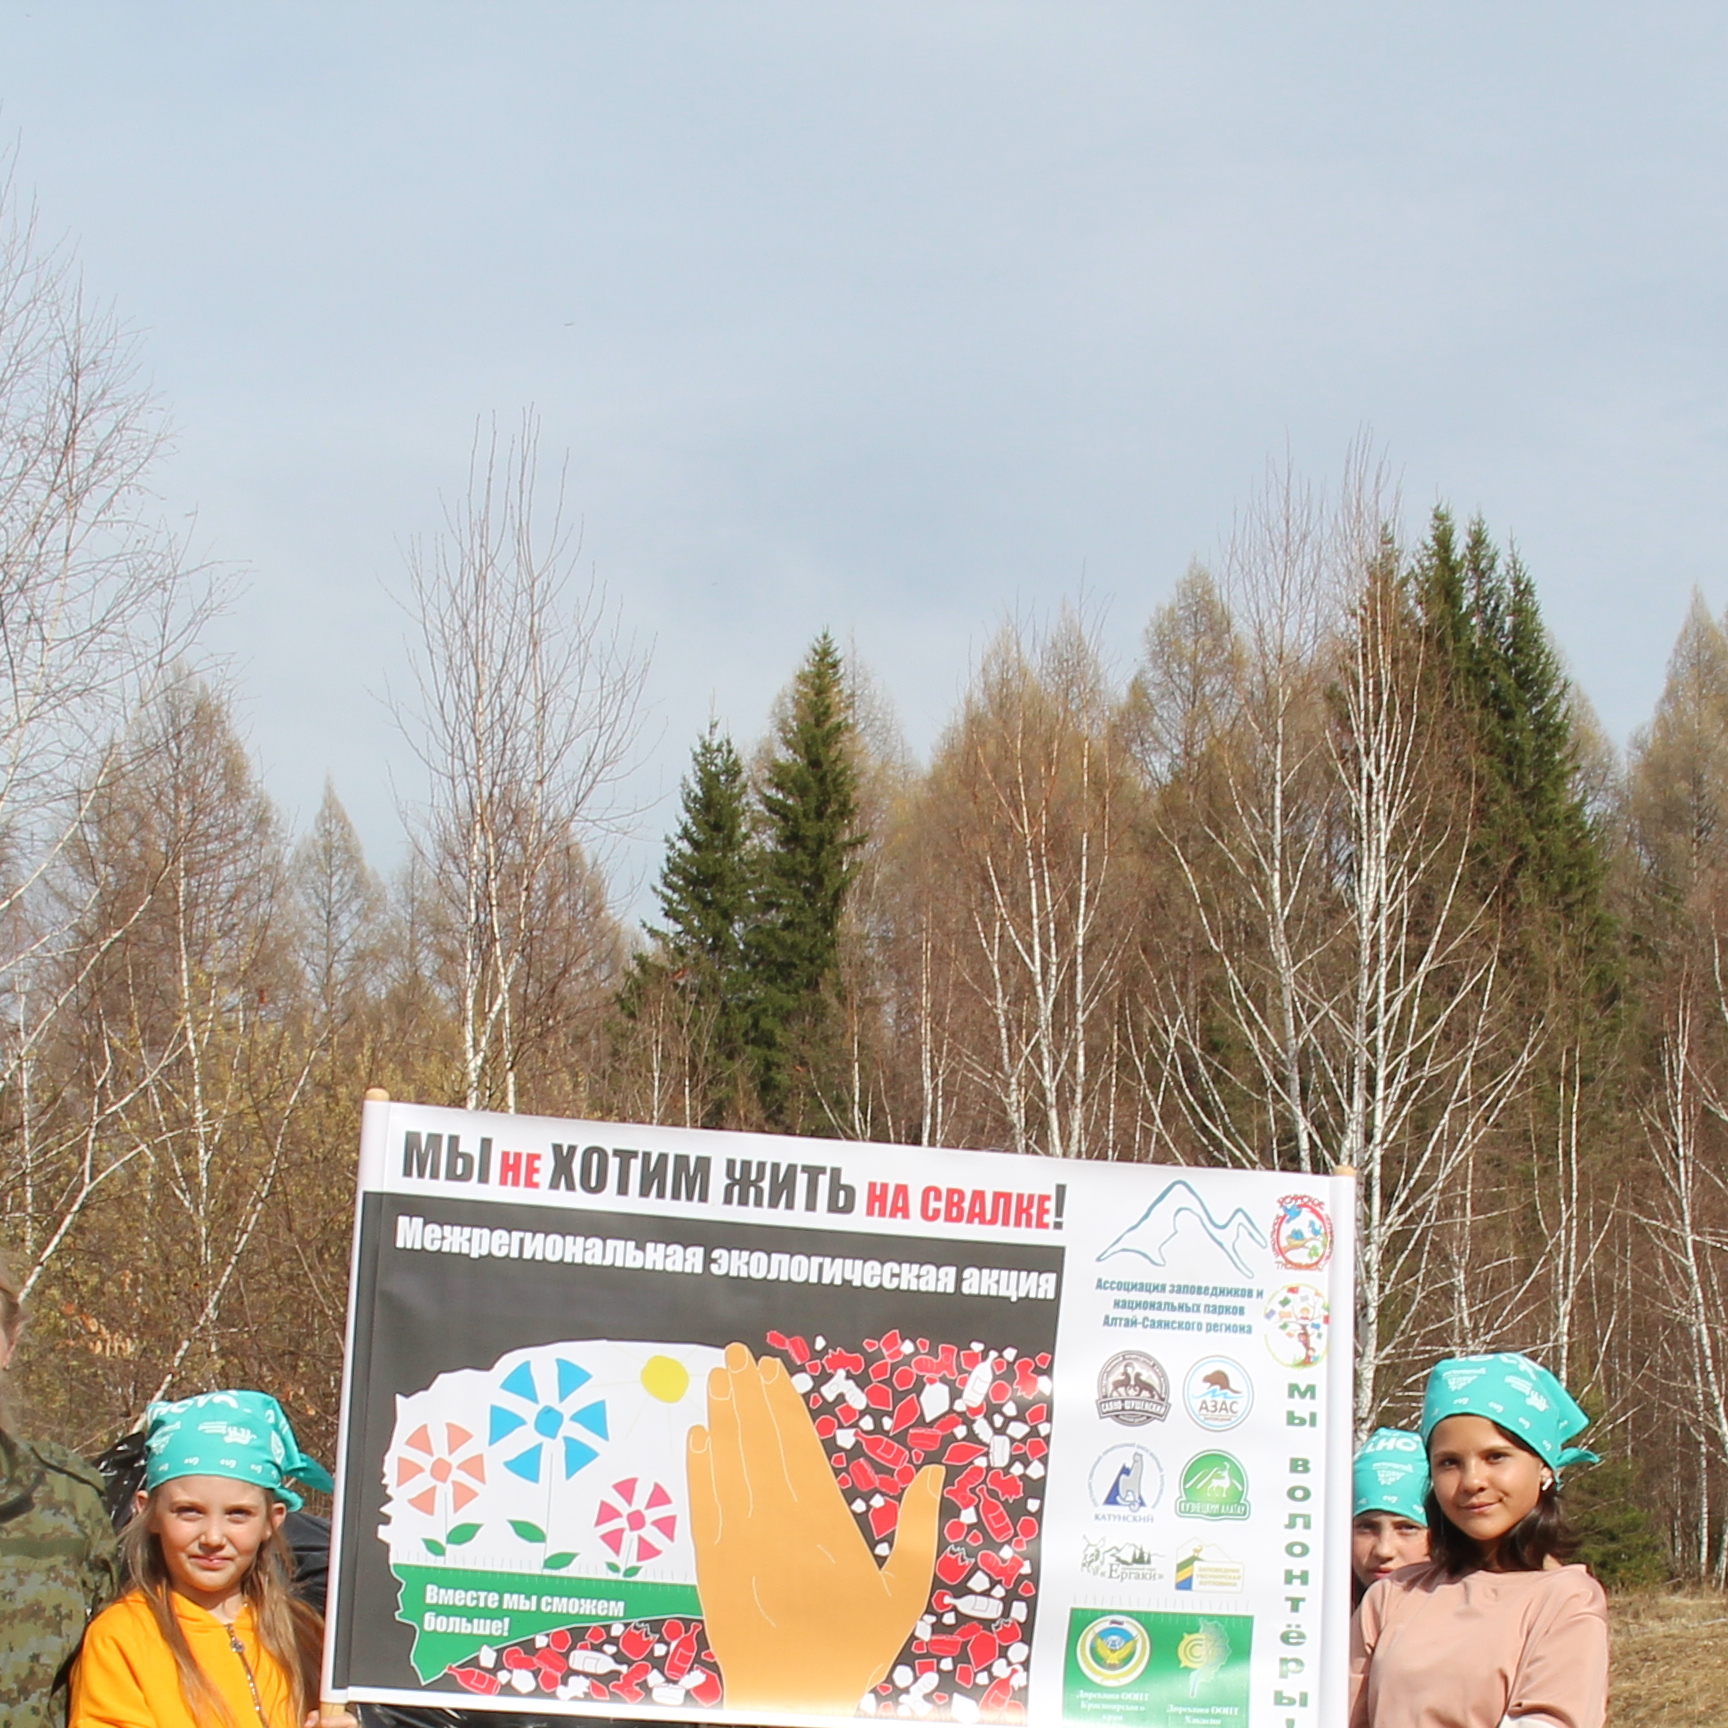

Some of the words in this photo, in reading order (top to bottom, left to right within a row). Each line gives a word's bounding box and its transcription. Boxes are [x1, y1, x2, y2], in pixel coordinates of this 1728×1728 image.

[402, 1130, 493, 1185] МЫ
[499, 1150, 542, 1189] НЕ
[548, 1142, 713, 1204] ХОТИМ
[722, 1157, 857, 1214] ЖИТЬ
[866, 1181, 911, 1219] НА
[920, 1183, 1067, 1230] СВАЛКЕ!
[395, 1214, 705, 1274] Межрегиональная
[710, 1247, 957, 1294] экологическая
[960, 1266, 1057, 1302] акция
[1096, 1277, 1166, 1294] Ассоциация
[1169, 1284, 1253, 1299] заповедников
[1255, 1288, 1264, 1299] и
[1113, 1298, 1201, 1315] национальных
[1204, 1304, 1245, 1317] парков
[1103, 1314, 1203, 1332] Алтай-Саянского
[1205, 1322, 1253, 1336] региона
[1198, 1400, 1239, 1414] АЗАС
[1094, 1512, 1154, 1524] КАТУНСКИЙ
[425, 1584, 500, 1609] Вместе
[502, 1593, 537, 1611] мы
[540, 1595, 625, 1617] сможем
[423, 1611, 511, 1637] больше!
